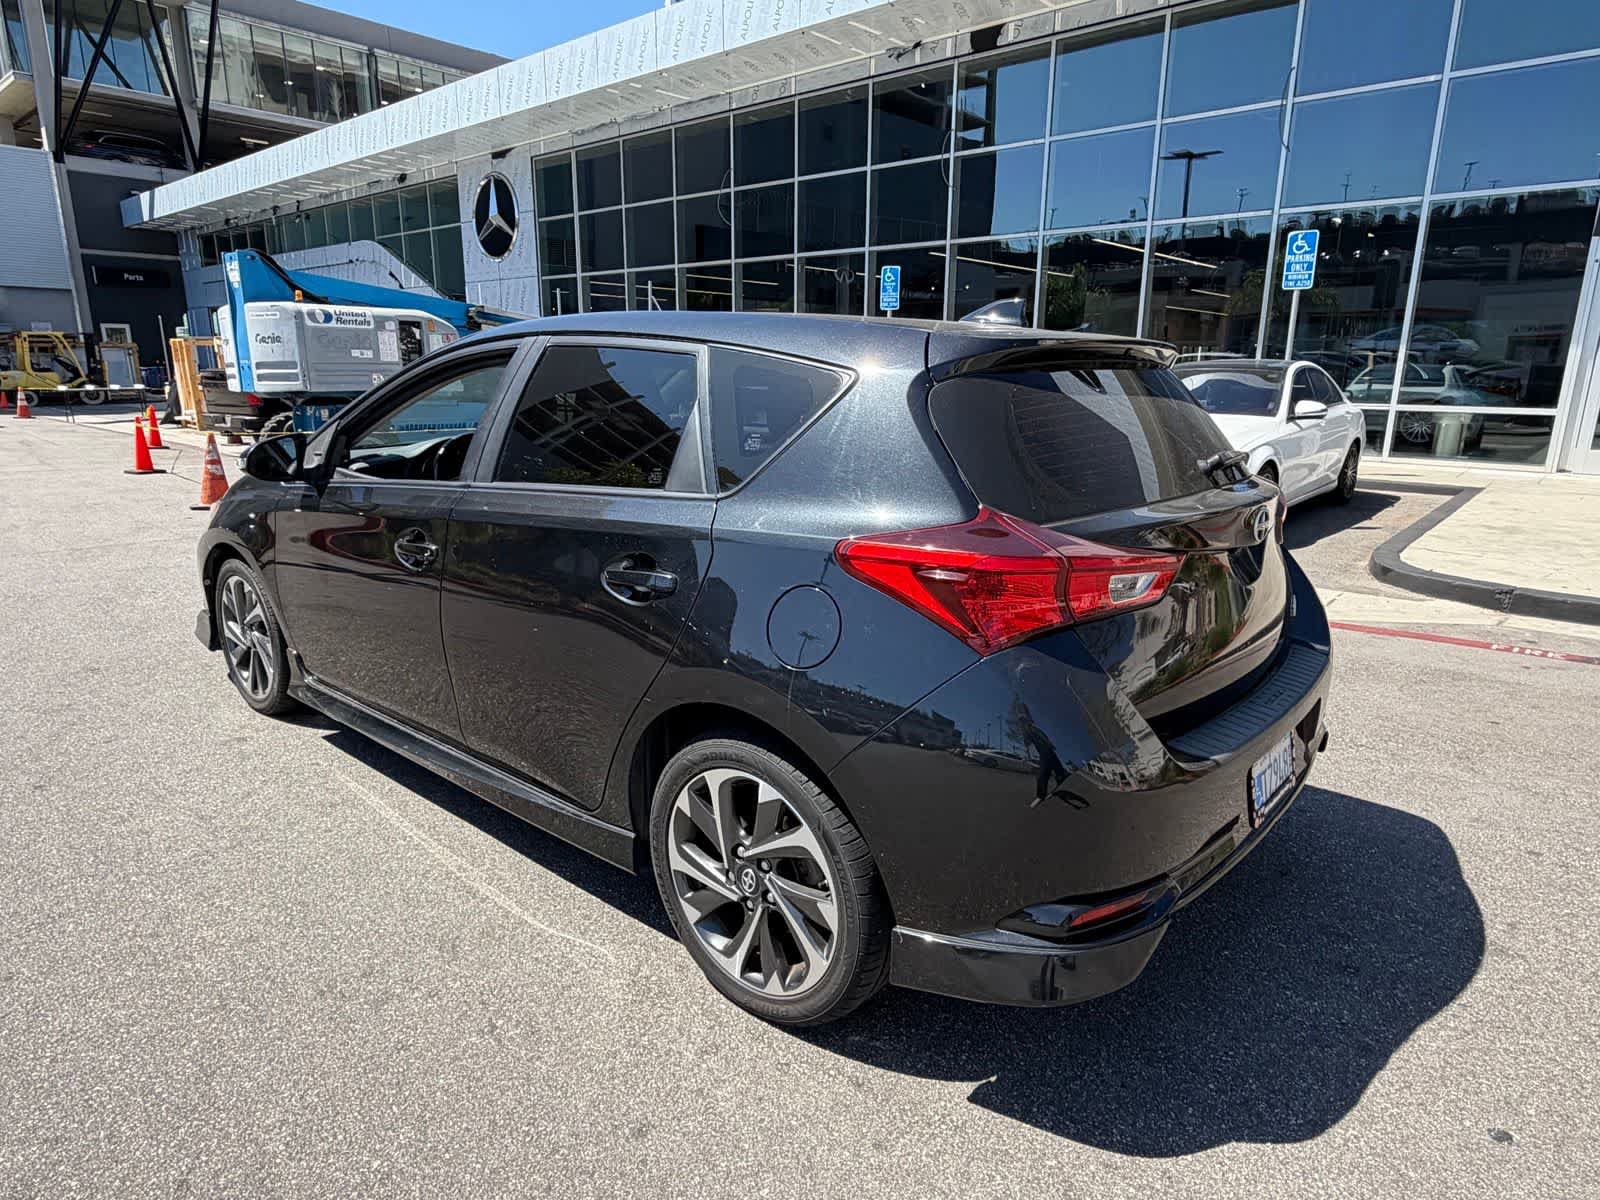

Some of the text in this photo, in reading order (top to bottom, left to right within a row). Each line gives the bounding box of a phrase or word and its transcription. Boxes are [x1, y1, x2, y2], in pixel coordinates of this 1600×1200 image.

[672, 15, 686, 61] ALPOLIC
[700, 7, 714, 52] ALPOLIC
[613, 36, 625, 79] ALPOLIC
[638, 28, 650, 72] ALPOLIC
[555, 57, 565, 97] ALPOLIC
[576, 48, 587, 91] ALPOLIC
[1286, 254, 1314, 263] PARKING
[1290, 263, 1308, 272] ONLY
[123, 272, 145, 281] Parts
[334, 309, 368, 318] United
[335, 317, 371, 327] Rentals
[255, 332, 283, 345] Genie
